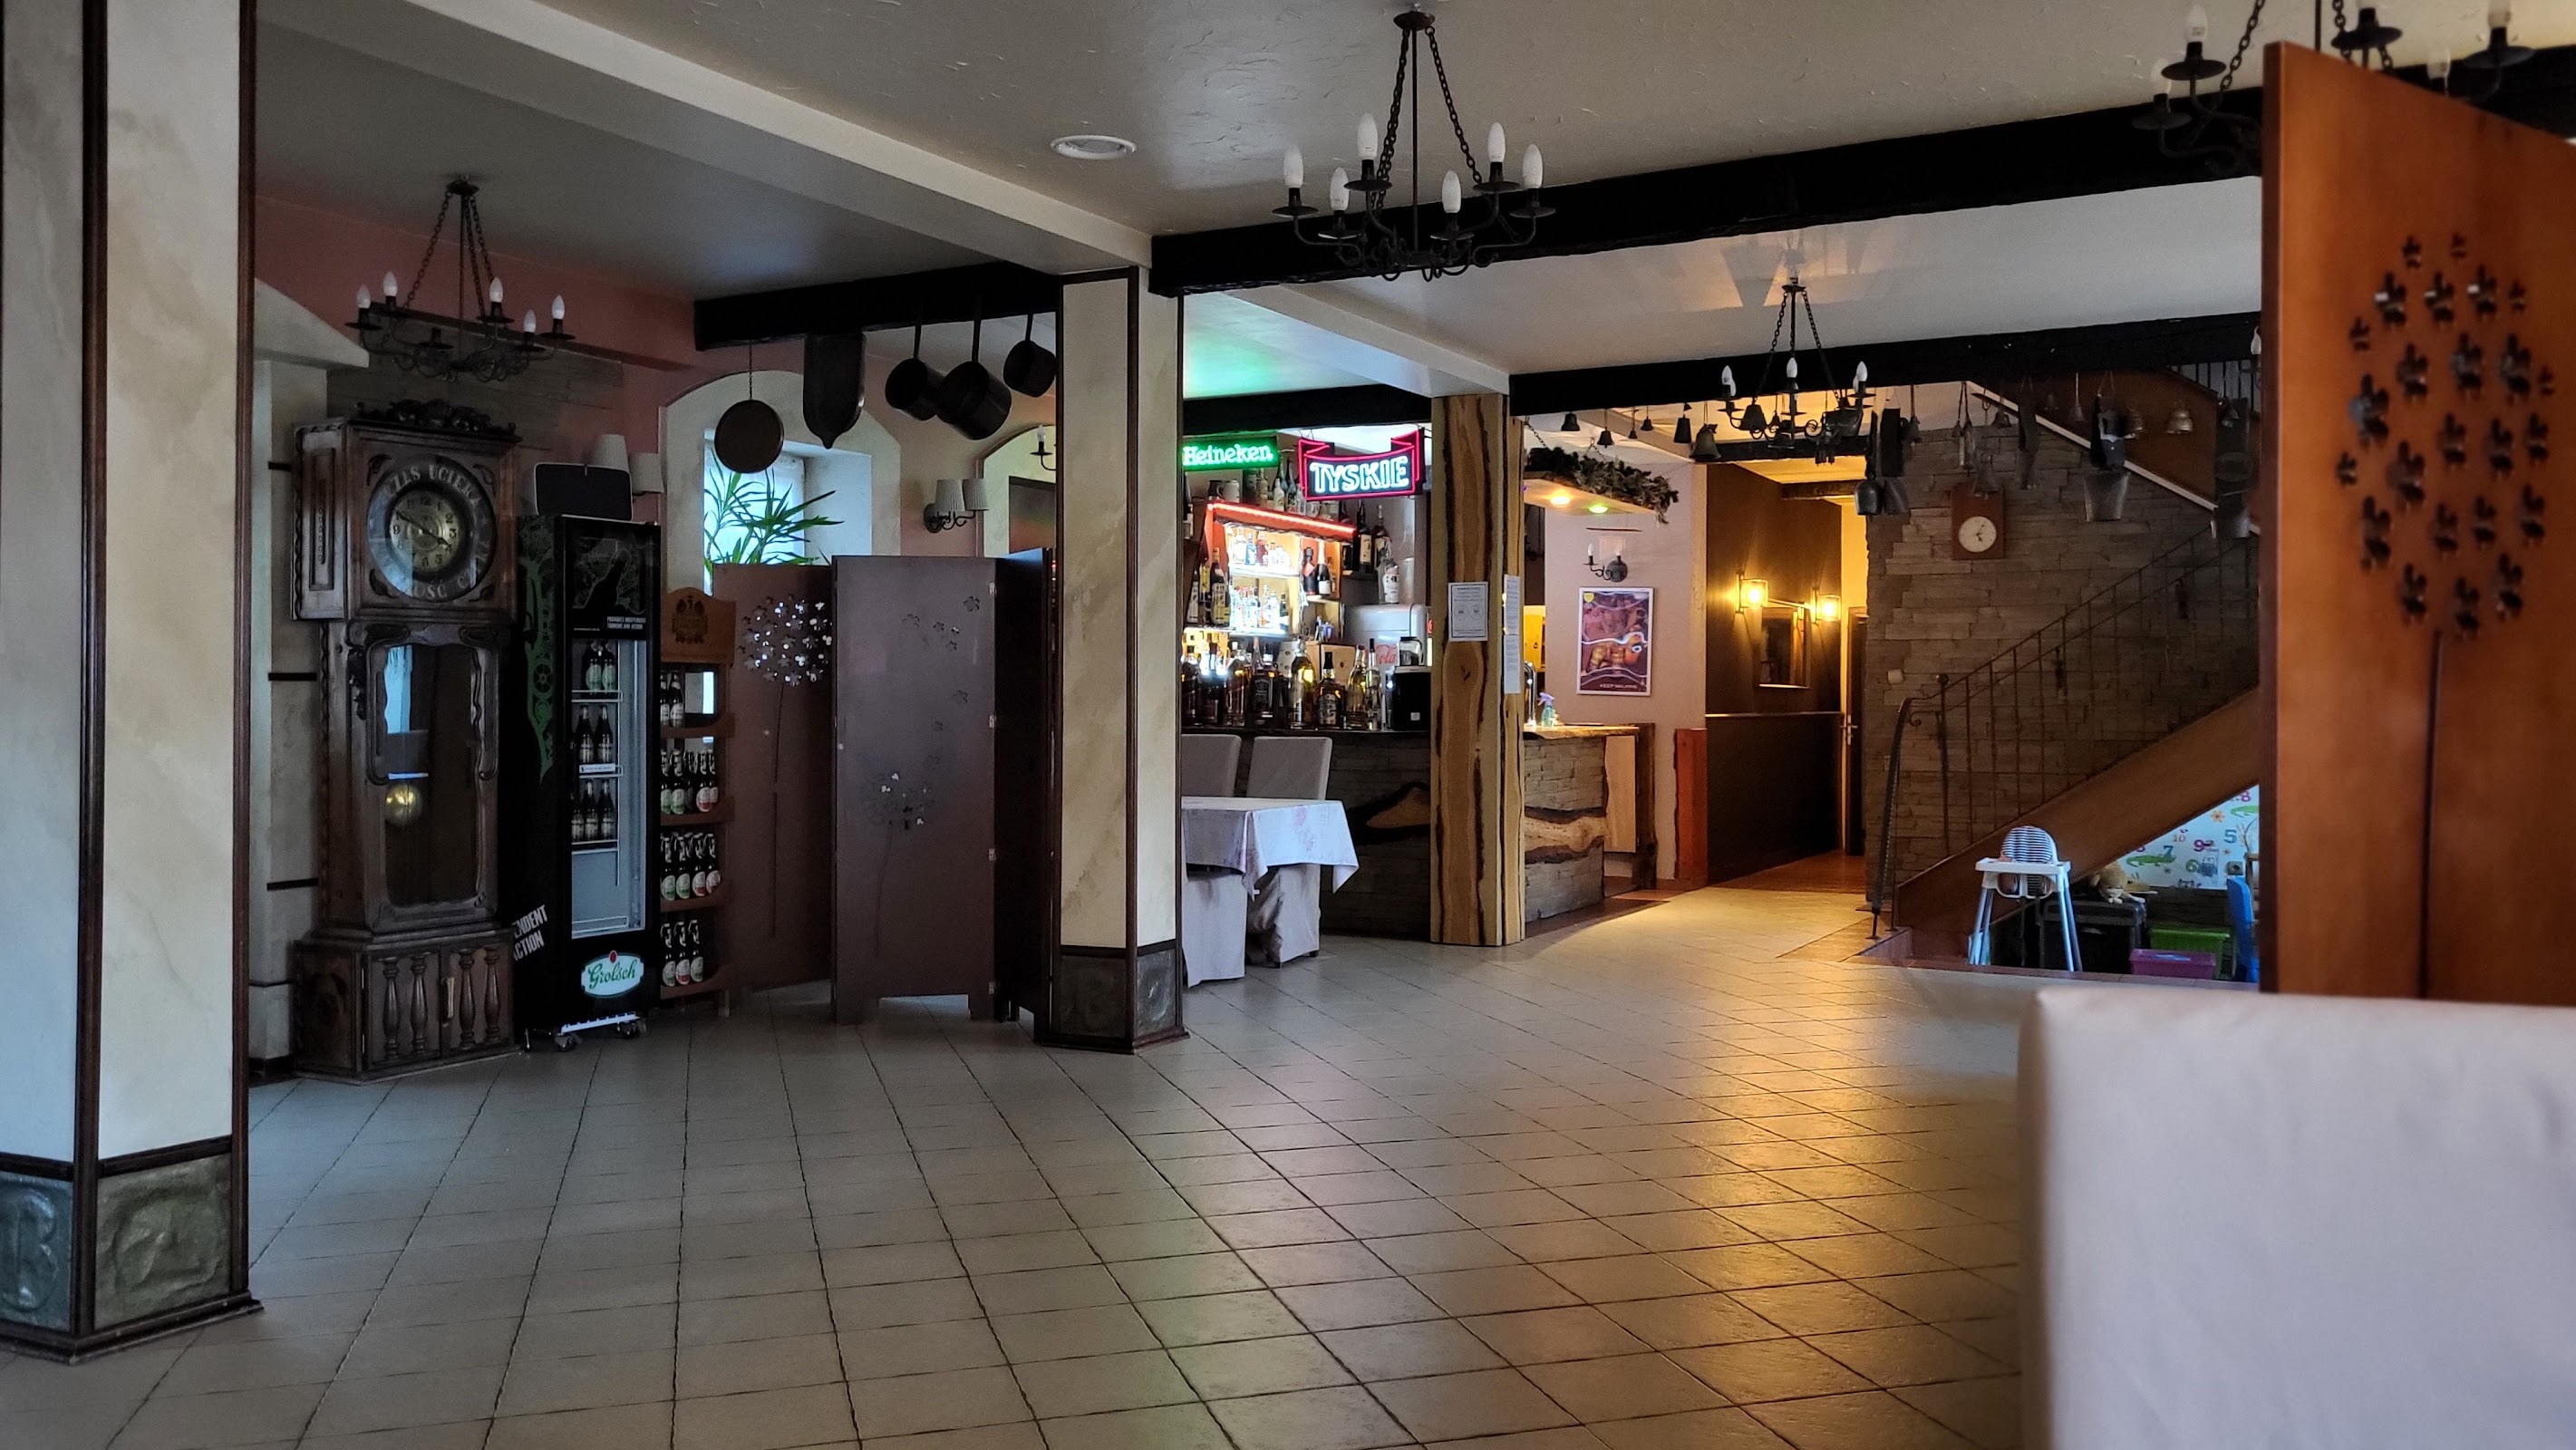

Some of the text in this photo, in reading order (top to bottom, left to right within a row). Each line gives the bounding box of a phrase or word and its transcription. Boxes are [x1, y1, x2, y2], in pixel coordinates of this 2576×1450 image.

[1182, 444, 1273, 466] Heineken
[1309, 456, 1409, 493] TYSKIE
[450, 528, 457, 539] 3
[2223, 829, 2237, 844] 5
[2164, 845, 2174, 857] 7
[2193, 839, 2205, 852] 9
[587, 959, 637, 990] Grolsch
